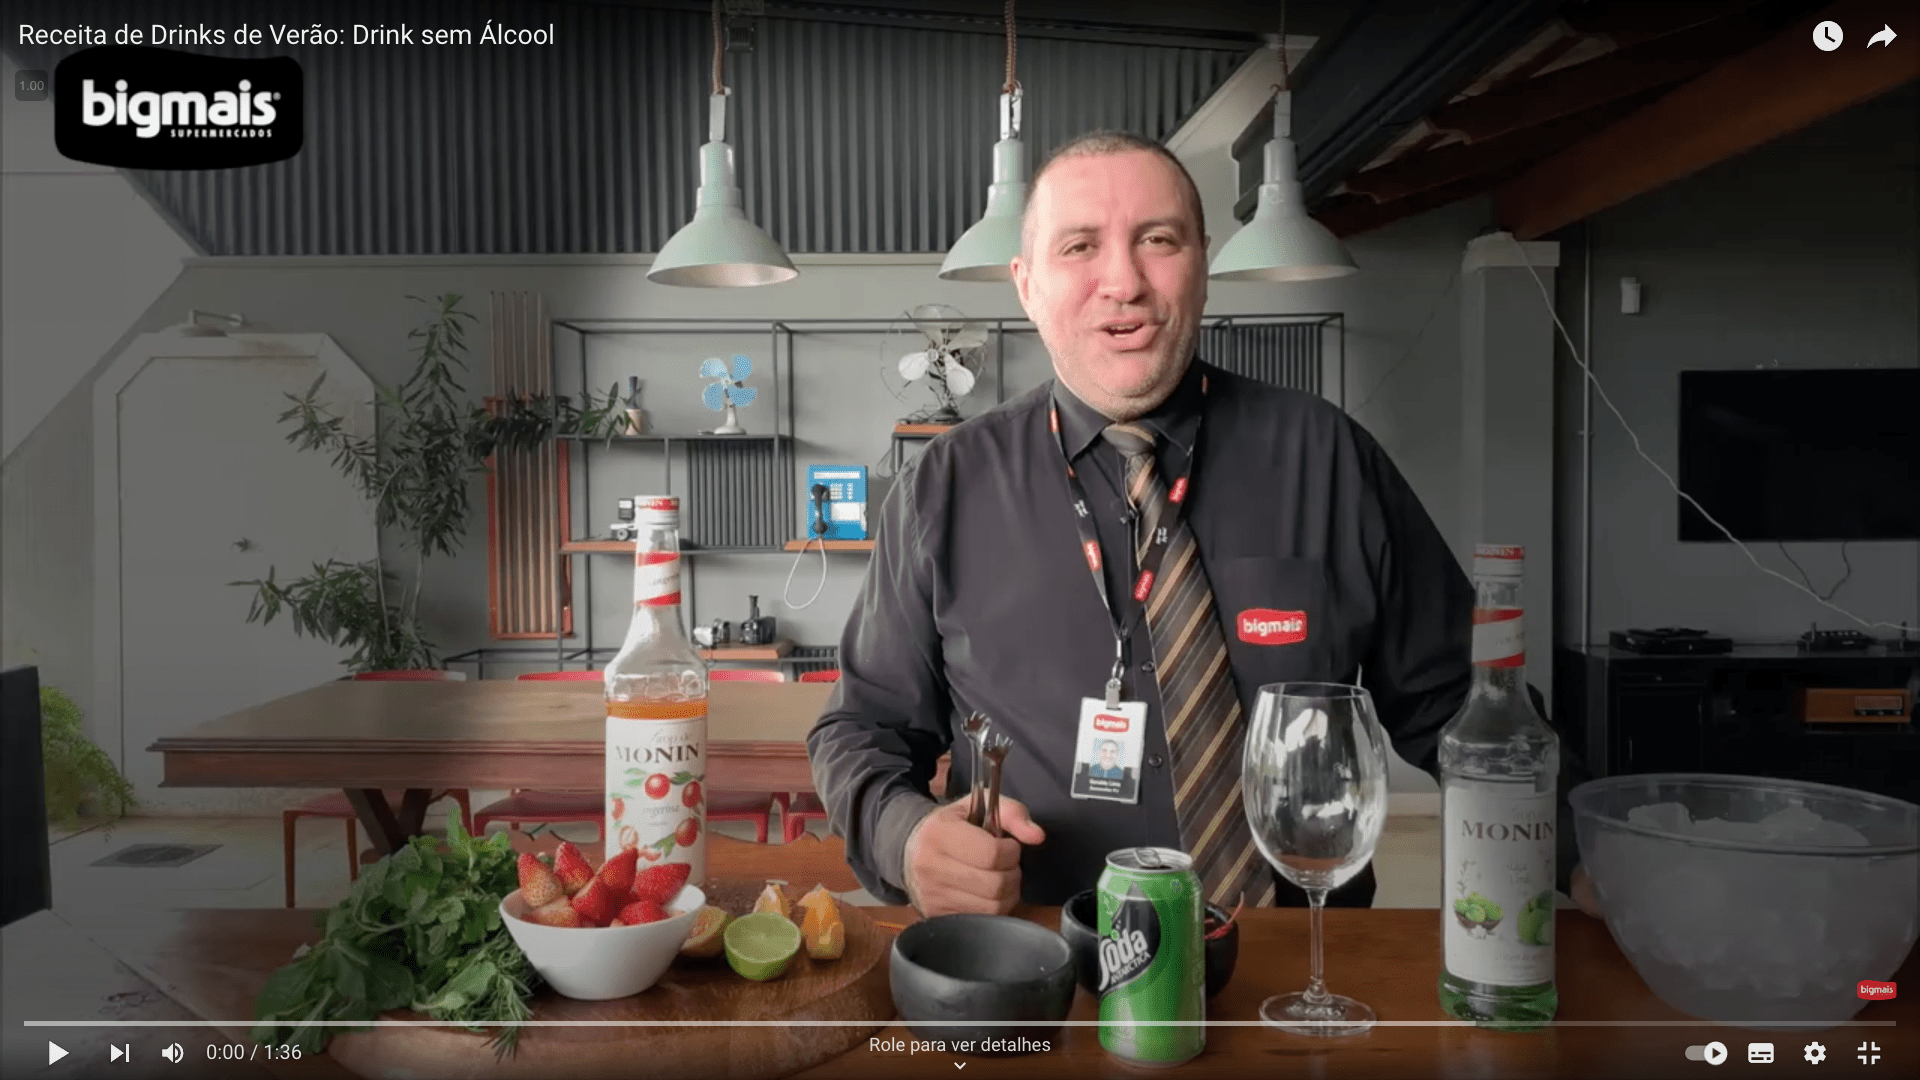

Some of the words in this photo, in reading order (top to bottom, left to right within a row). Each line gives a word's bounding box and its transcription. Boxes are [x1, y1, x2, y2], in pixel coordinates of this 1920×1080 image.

[1243, 617, 1303, 637] bigmais
[616, 743, 699, 763] MONIN
[1461, 819, 1554, 841] MONIN
[1099, 928, 1149, 991] Soda
[1111, 951, 1151, 985] ANTARCTICA
